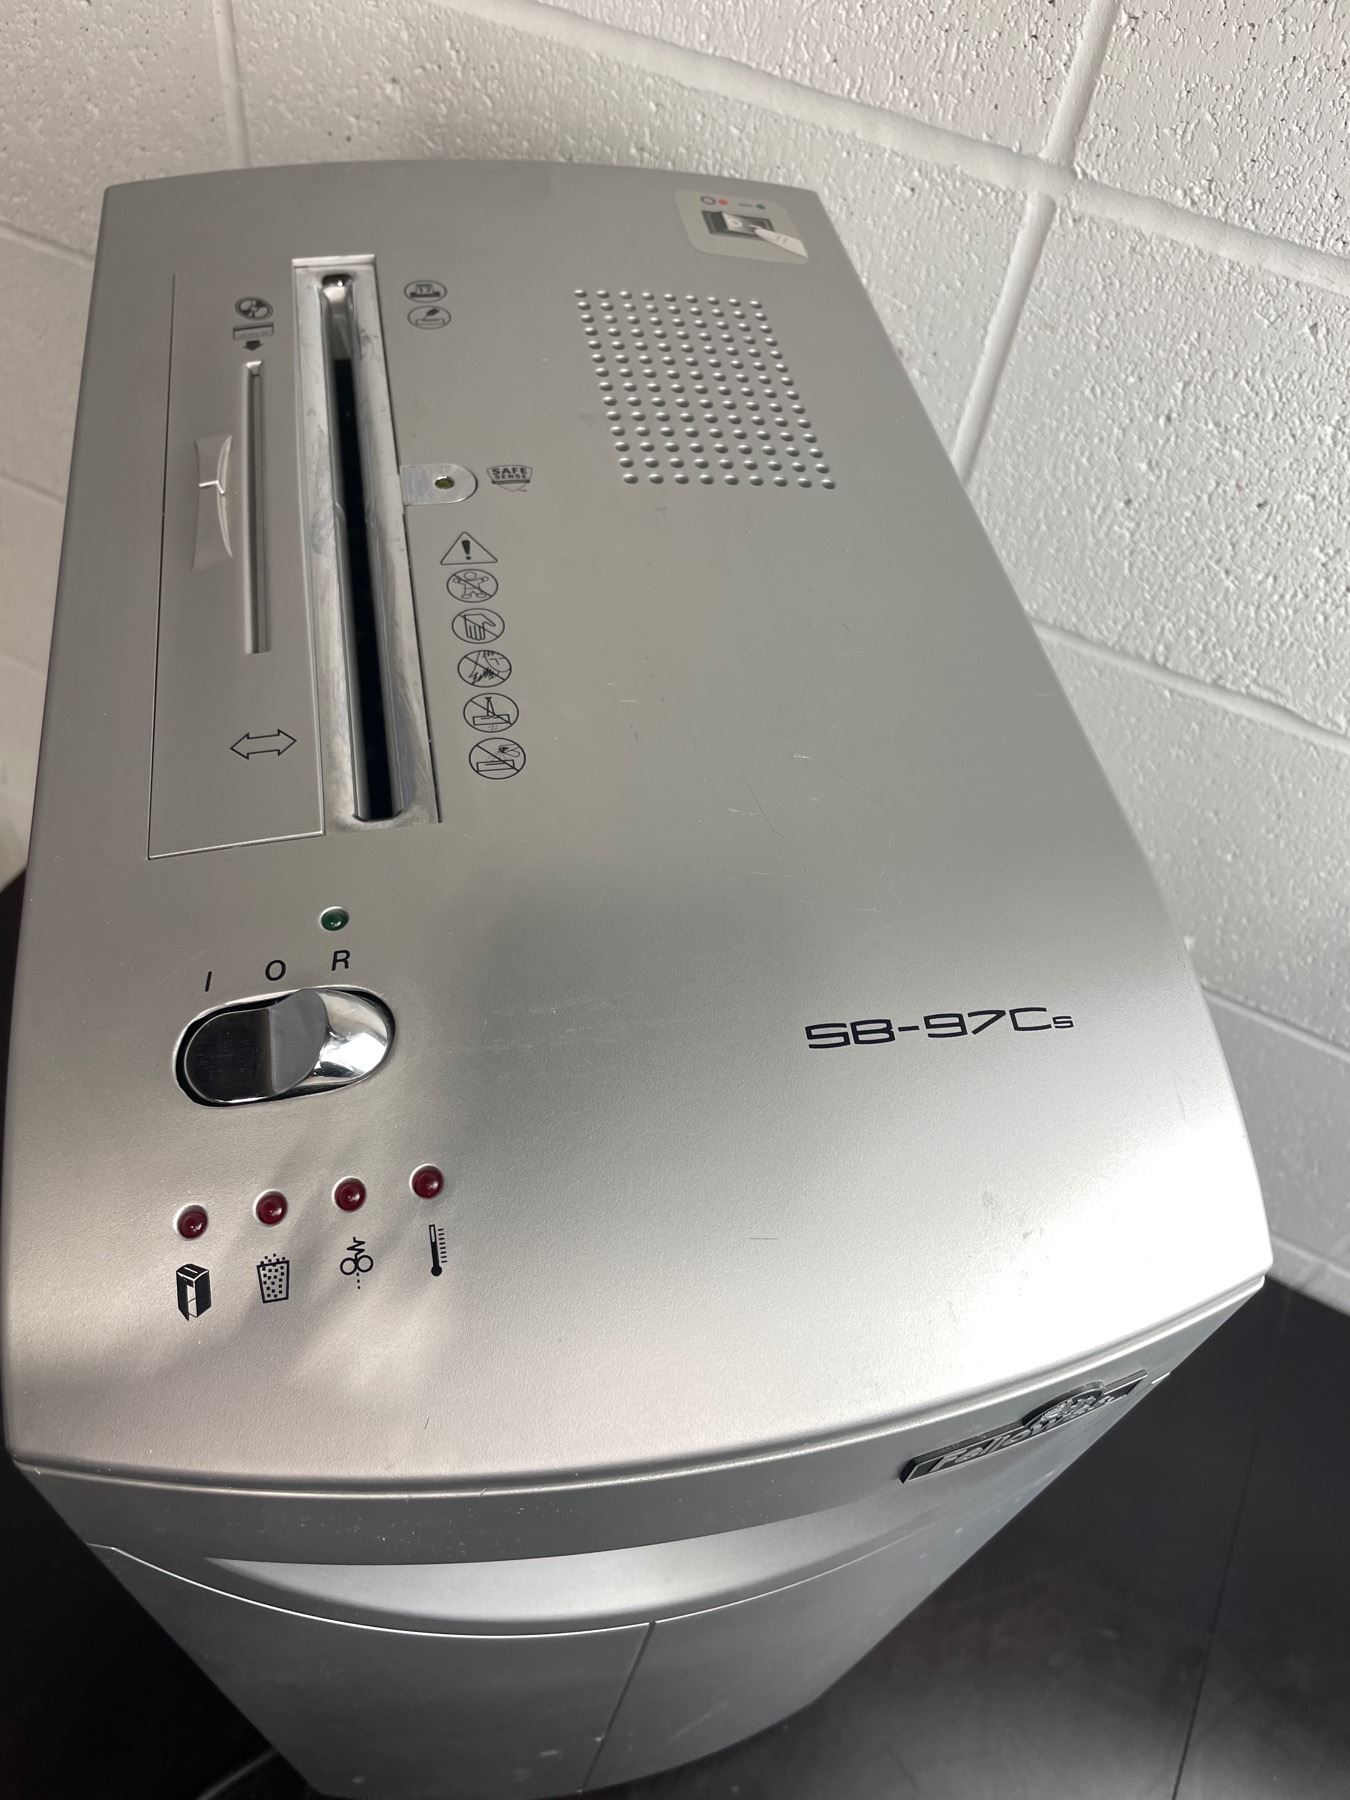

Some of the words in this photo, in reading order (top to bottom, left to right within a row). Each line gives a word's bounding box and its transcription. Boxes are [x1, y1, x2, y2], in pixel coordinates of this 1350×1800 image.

[491, 467, 528, 475] SAFE
[331, 949, 350, 971] R
[805, 1006, 1074, 1049] SB-97Cs
